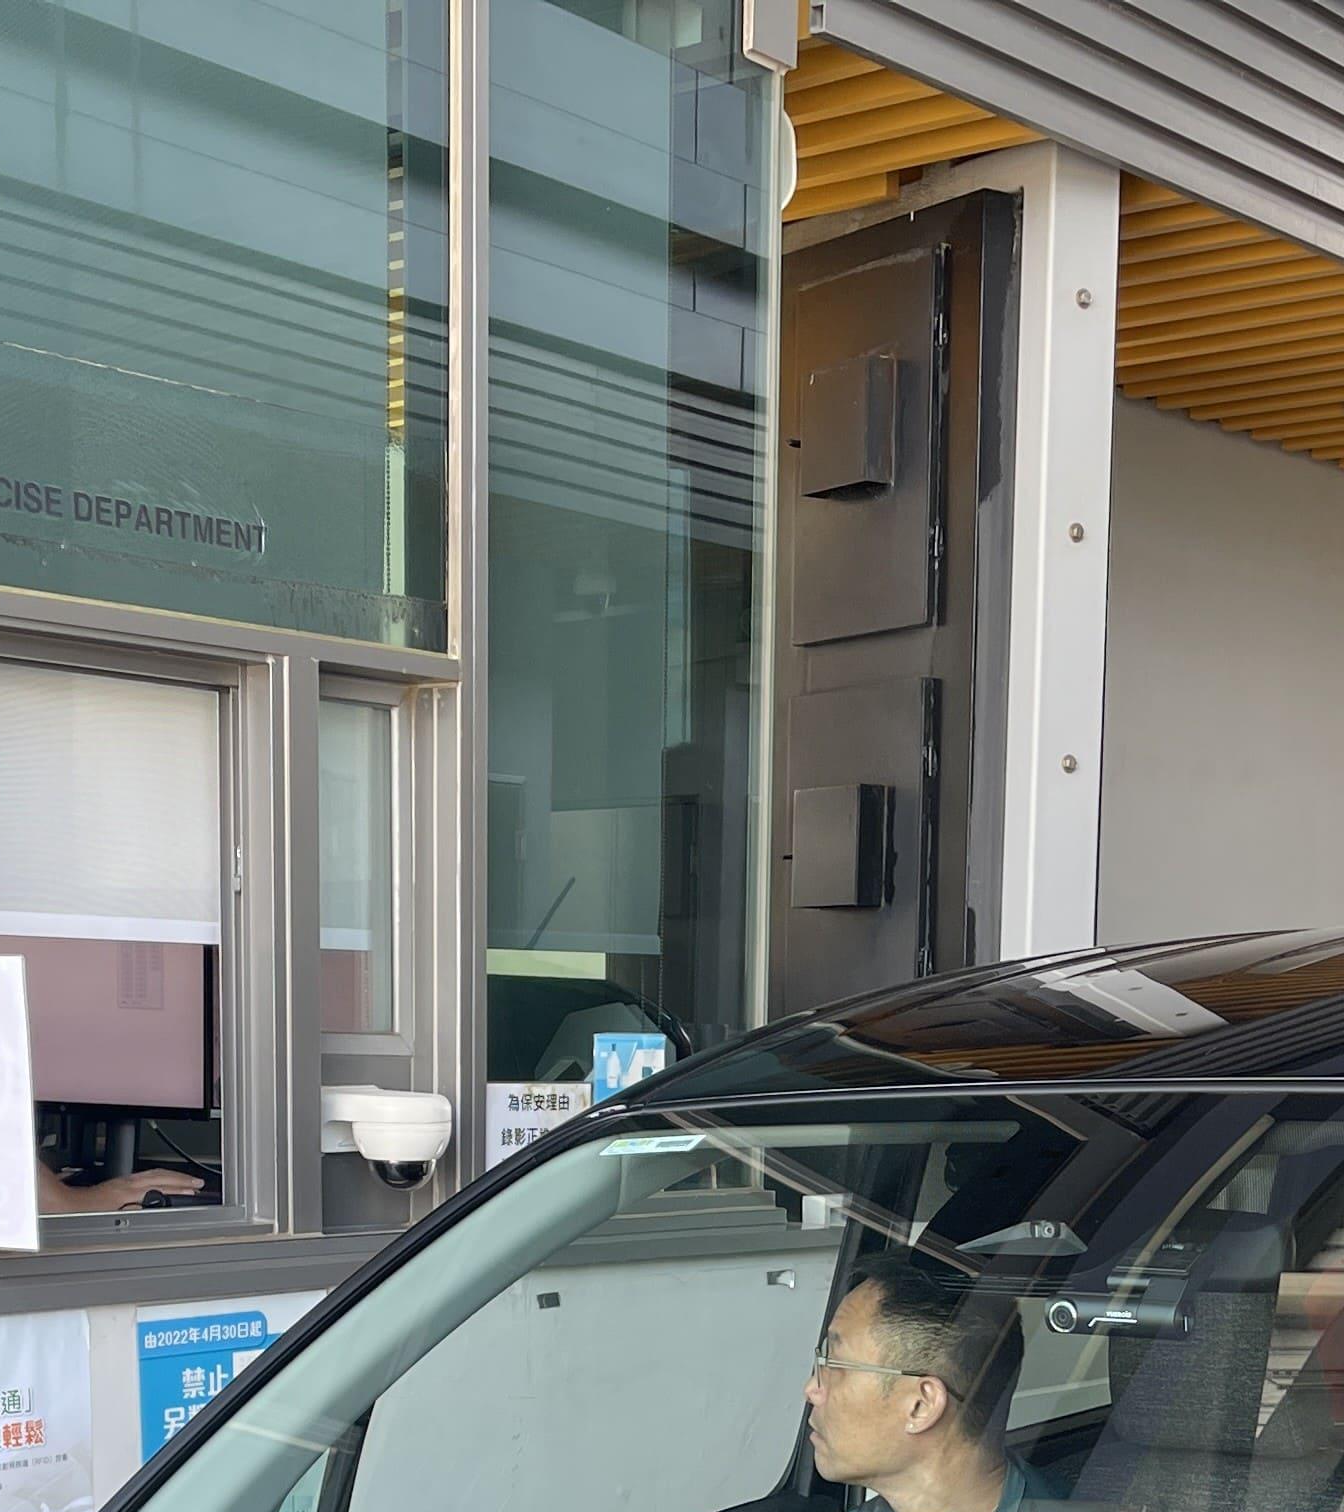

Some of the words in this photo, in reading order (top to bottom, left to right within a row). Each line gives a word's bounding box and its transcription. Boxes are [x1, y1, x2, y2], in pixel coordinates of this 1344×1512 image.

[73, 491, 265, 553] DEPARTMENT
[508, 1093, 570, 1111] 為保安理由
[144, 1320, 263, 1349] 由2022年4月30日起
